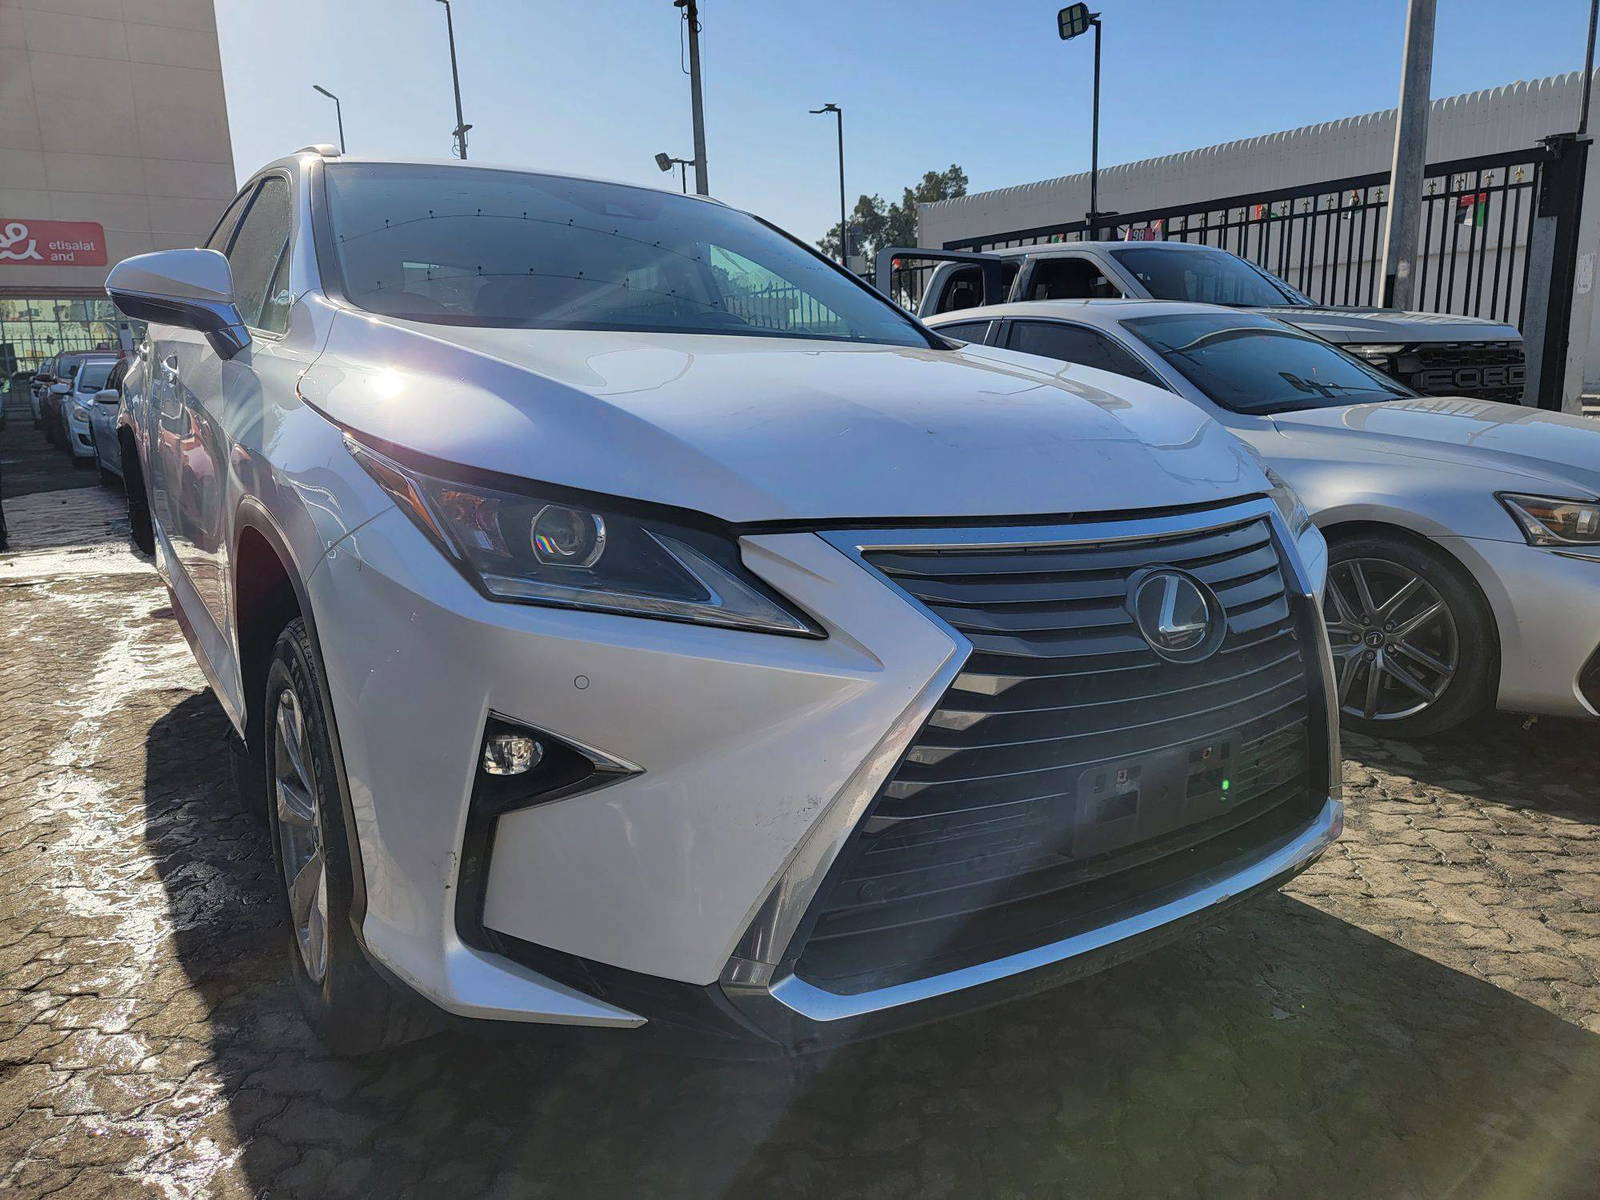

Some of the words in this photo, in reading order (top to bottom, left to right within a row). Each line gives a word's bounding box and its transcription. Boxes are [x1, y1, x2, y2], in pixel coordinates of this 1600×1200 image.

[48, 240, 96, 251] etisalat
[51, 251, 75, 261] and
[1421, 366, 1526, 388] FORD
